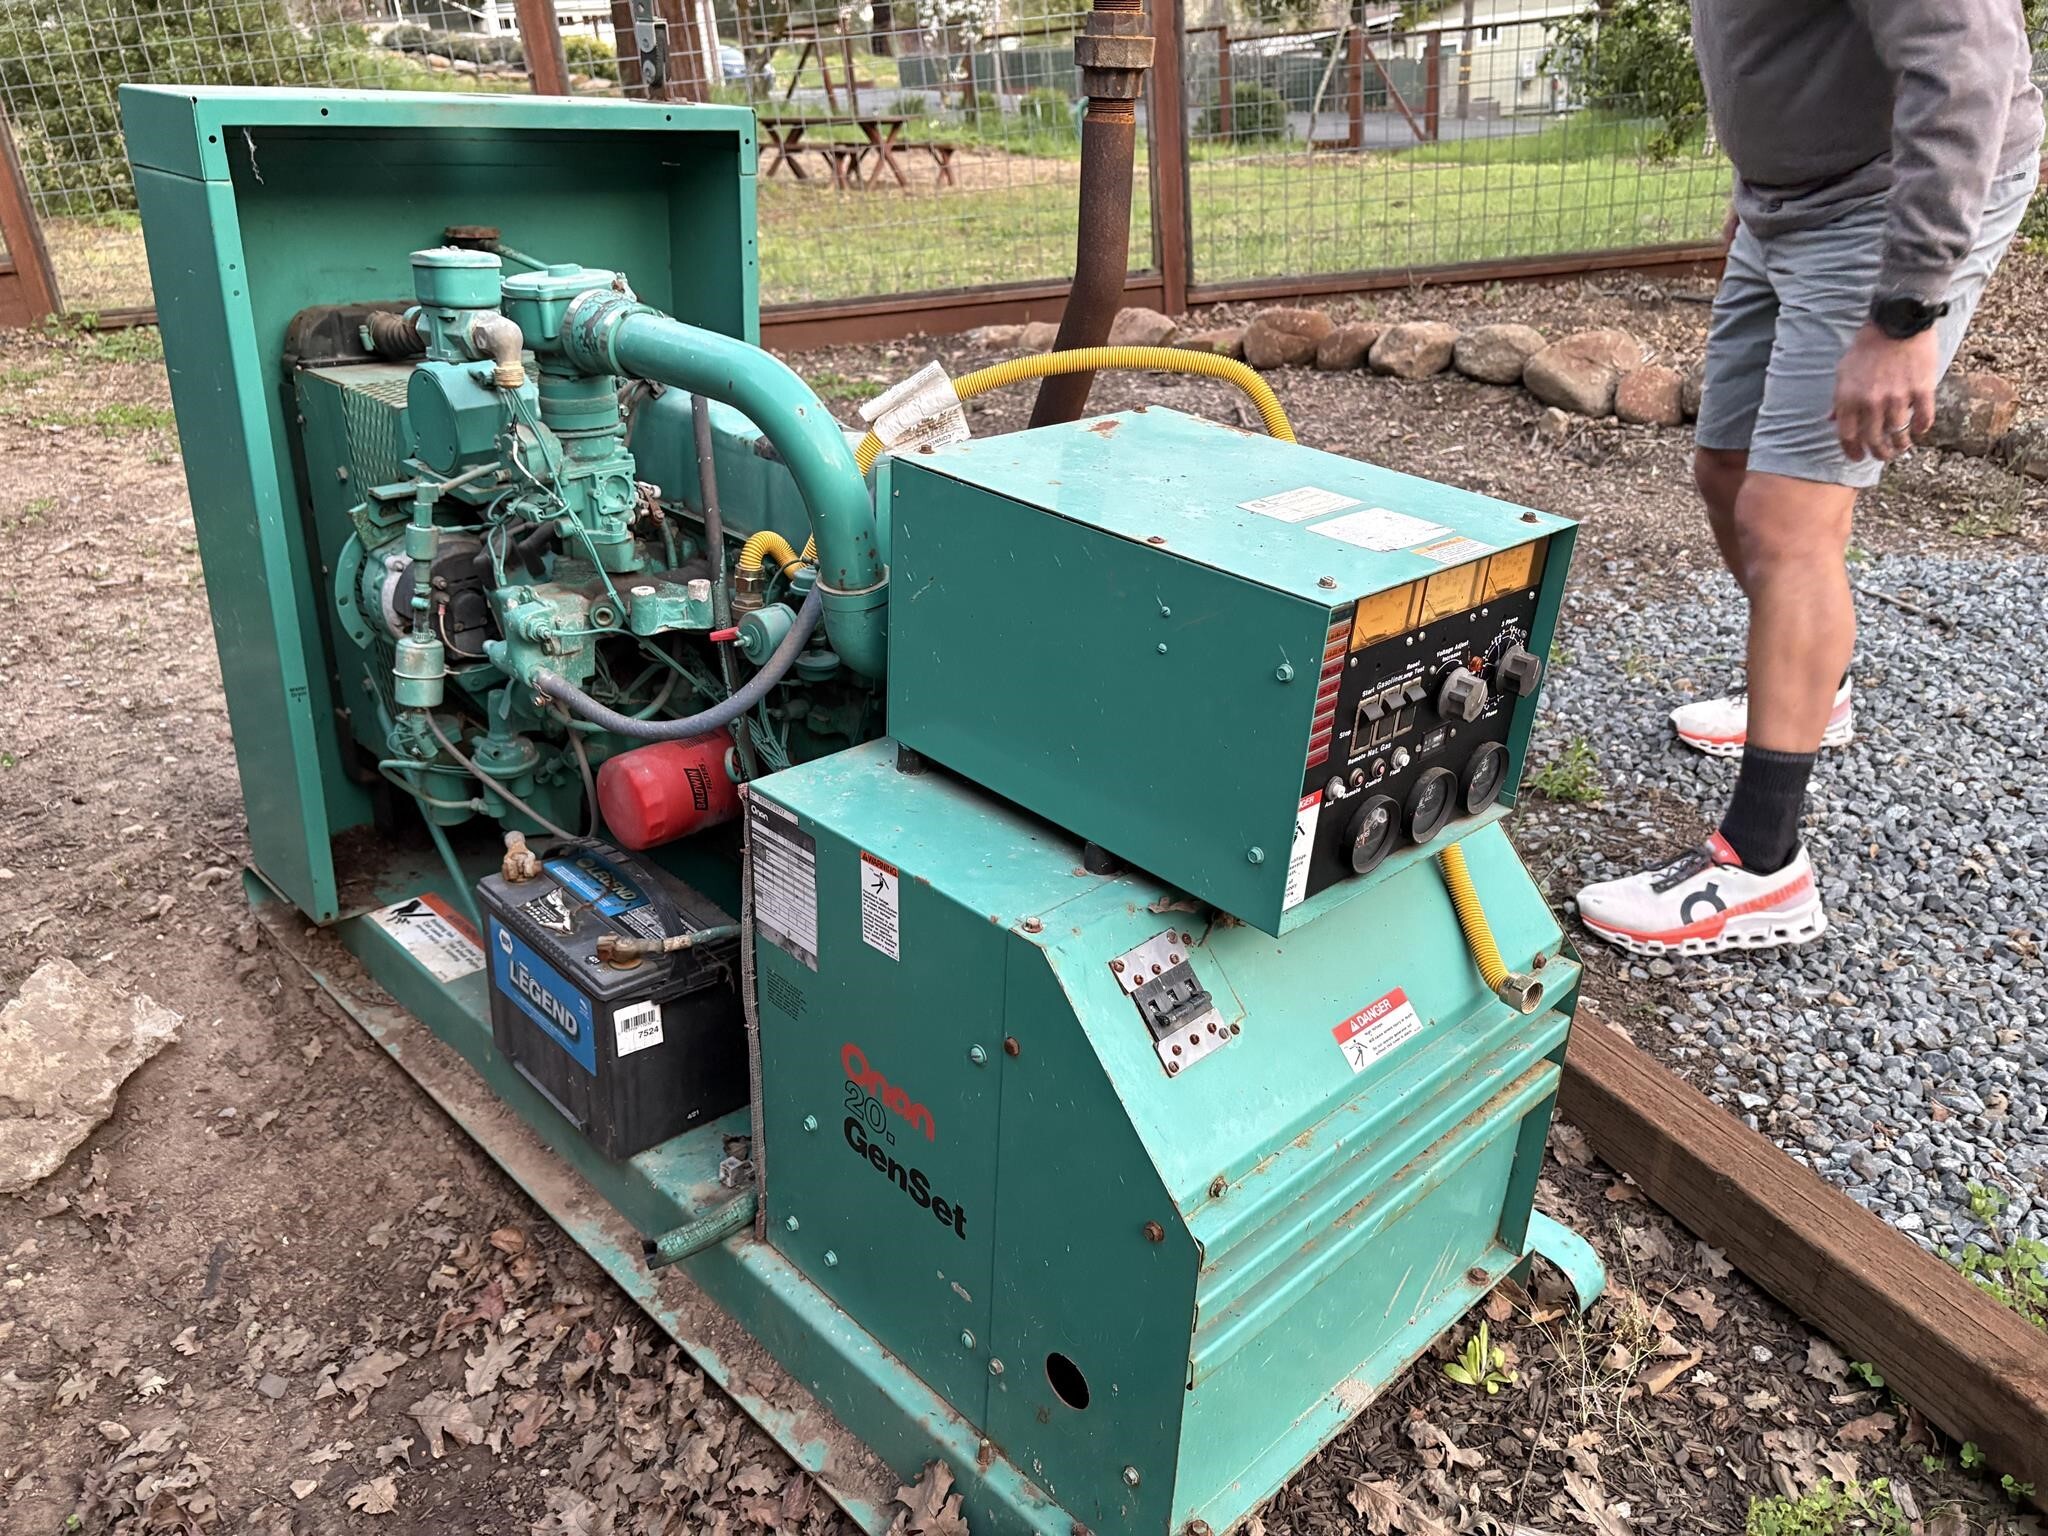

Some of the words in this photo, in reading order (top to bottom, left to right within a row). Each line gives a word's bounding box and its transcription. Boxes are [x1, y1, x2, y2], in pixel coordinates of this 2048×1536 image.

[1436, 646, 1454, 658] Voltage
[1454, 639, 1469, 650] Adjust
[1376, 674, 1401, 690] Gasoline
[1361, 686, 1375, 697] Start
[1339, 729, 1351, 740] Stop
[1380, 742, 1392, 752] Gas
[1347, 752, 1367, 766] Remote
[699, 762, 713, 792] FILTERS
[687, 769, 707, 810] BALDWIN
[866, 854, 897, 878] WARNING
[1356, 998, 1393, 1028] DANGER
[638, 1025, 660, 1039] 7524
[843, 1116, 967, 1241] GenSet
